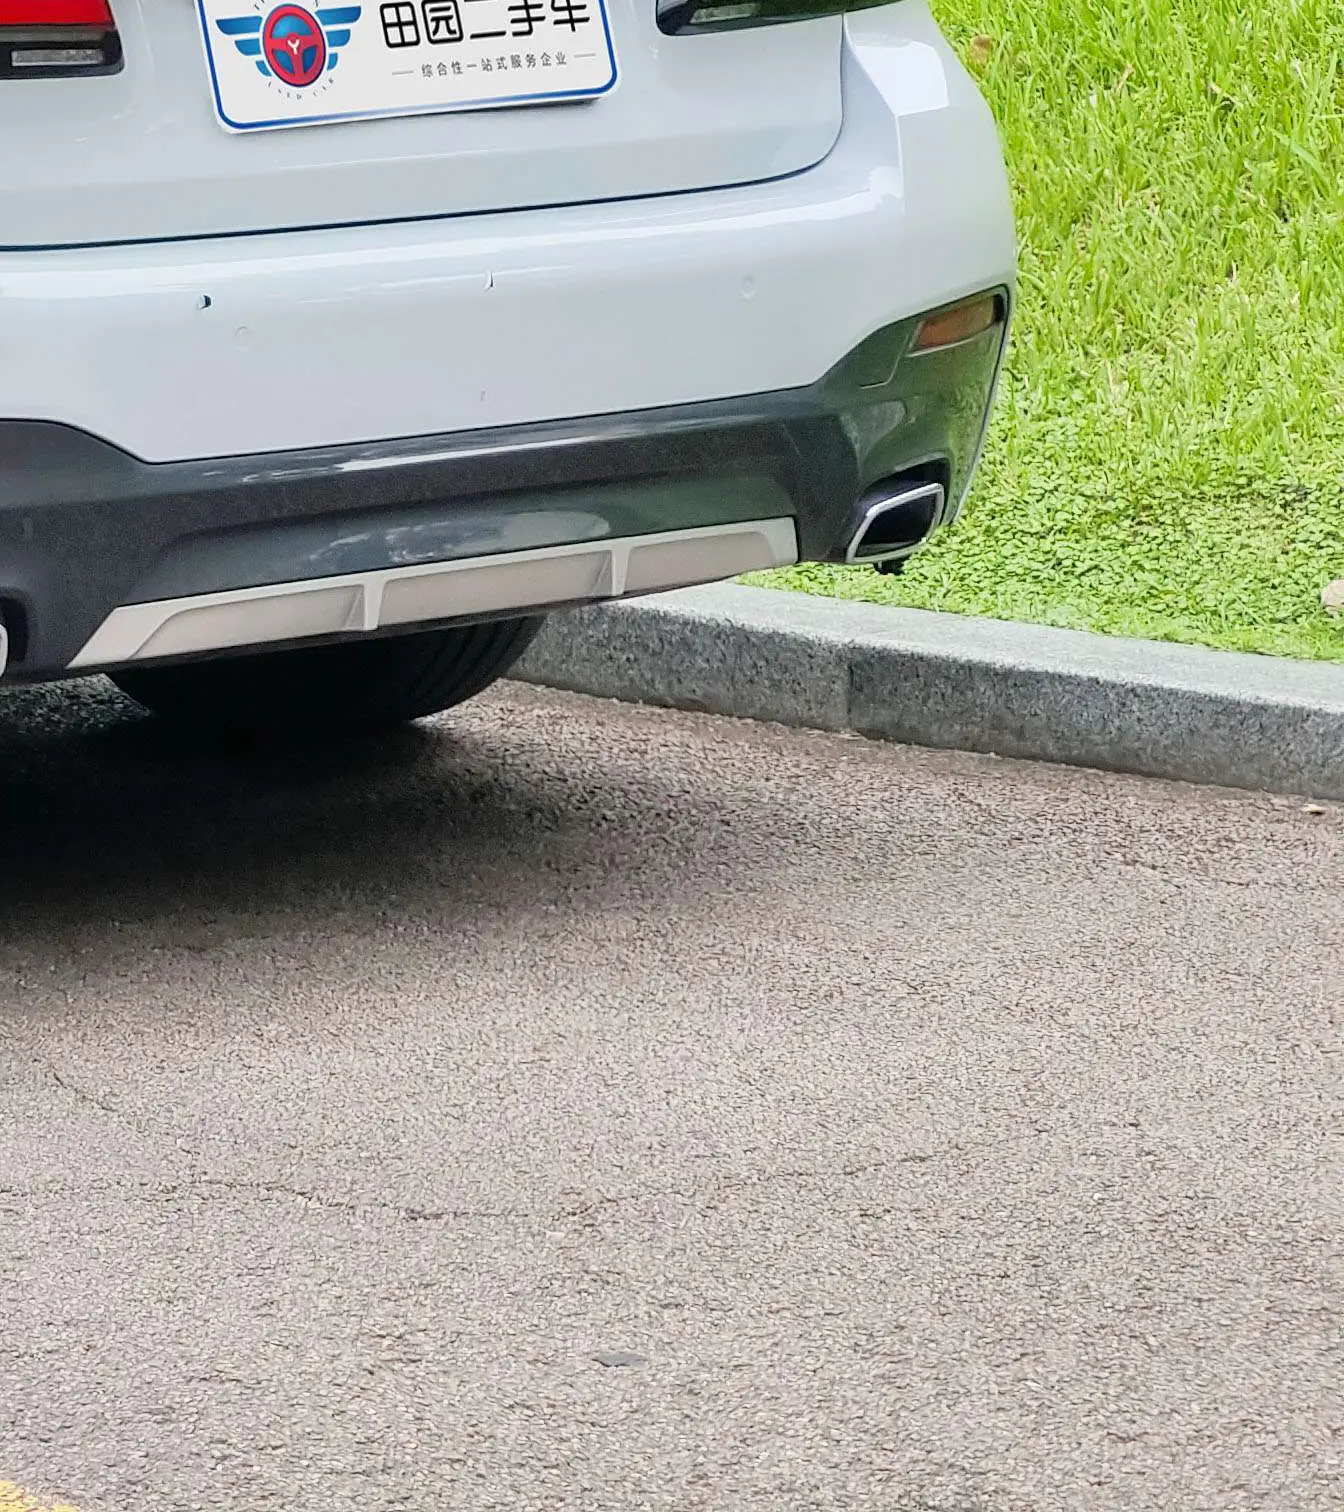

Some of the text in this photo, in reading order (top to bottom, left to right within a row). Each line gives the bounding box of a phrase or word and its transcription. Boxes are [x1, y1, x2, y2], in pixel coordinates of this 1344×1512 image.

[420, 50, 568, 79] 综合性一站式服务企业
